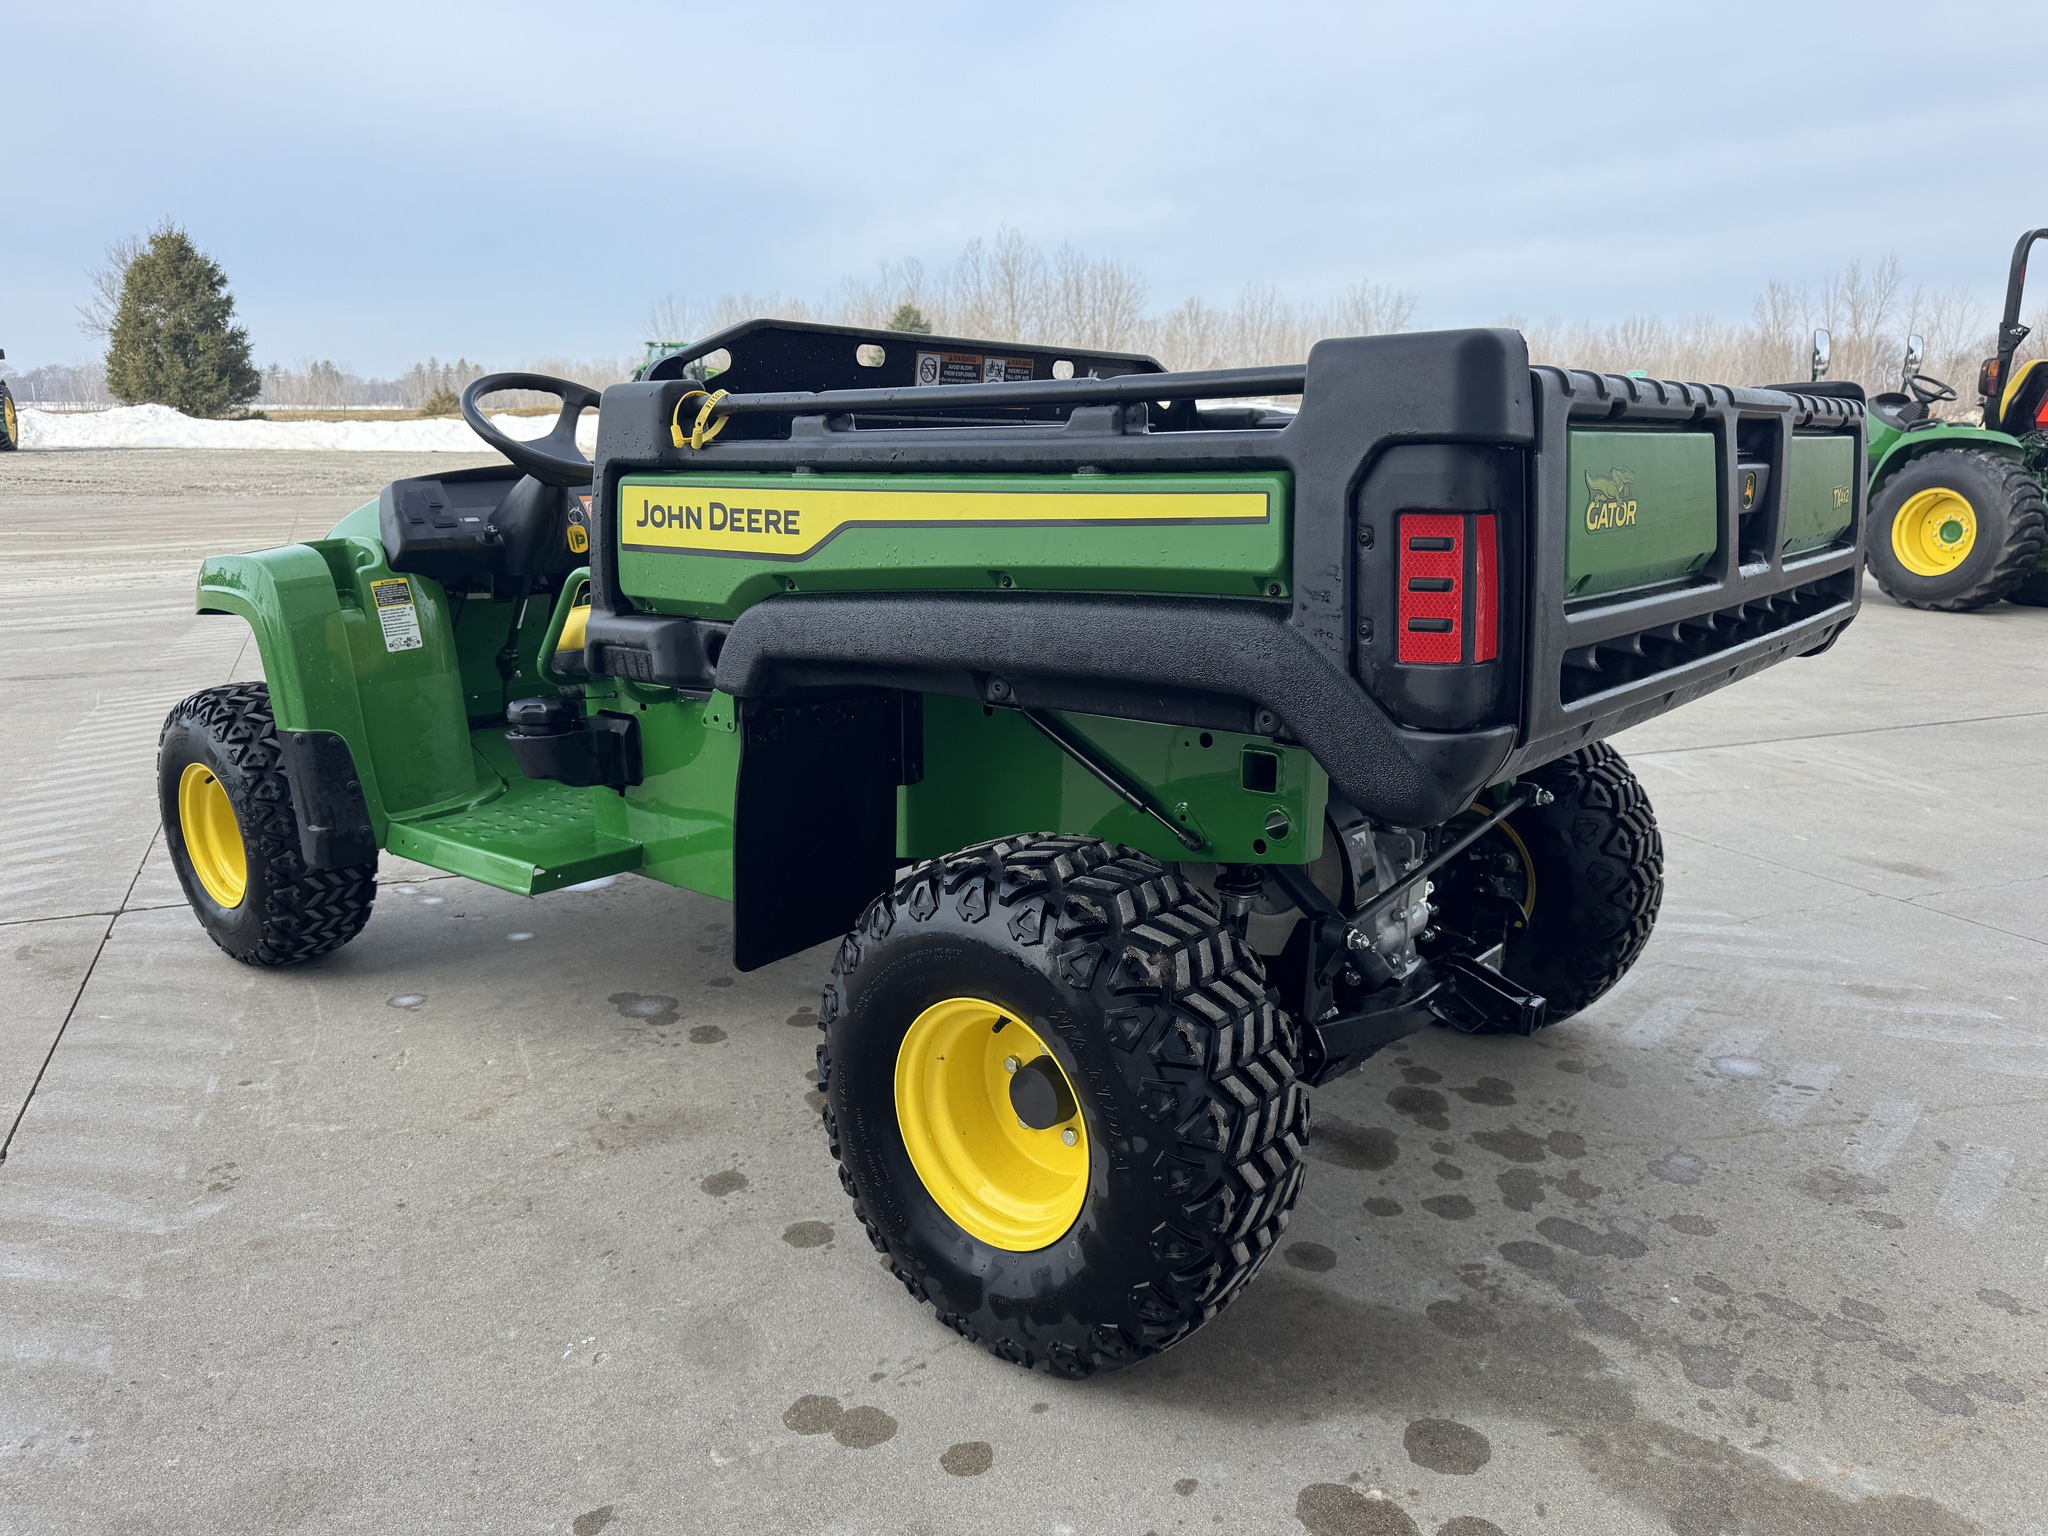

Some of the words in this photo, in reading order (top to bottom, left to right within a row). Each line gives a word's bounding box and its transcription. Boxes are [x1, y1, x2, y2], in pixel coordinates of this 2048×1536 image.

[636, 499, 702, 531] JOHN
[709, 501, 800, 535] DEERE
[1586, 499, 1638, 531] GATOR
